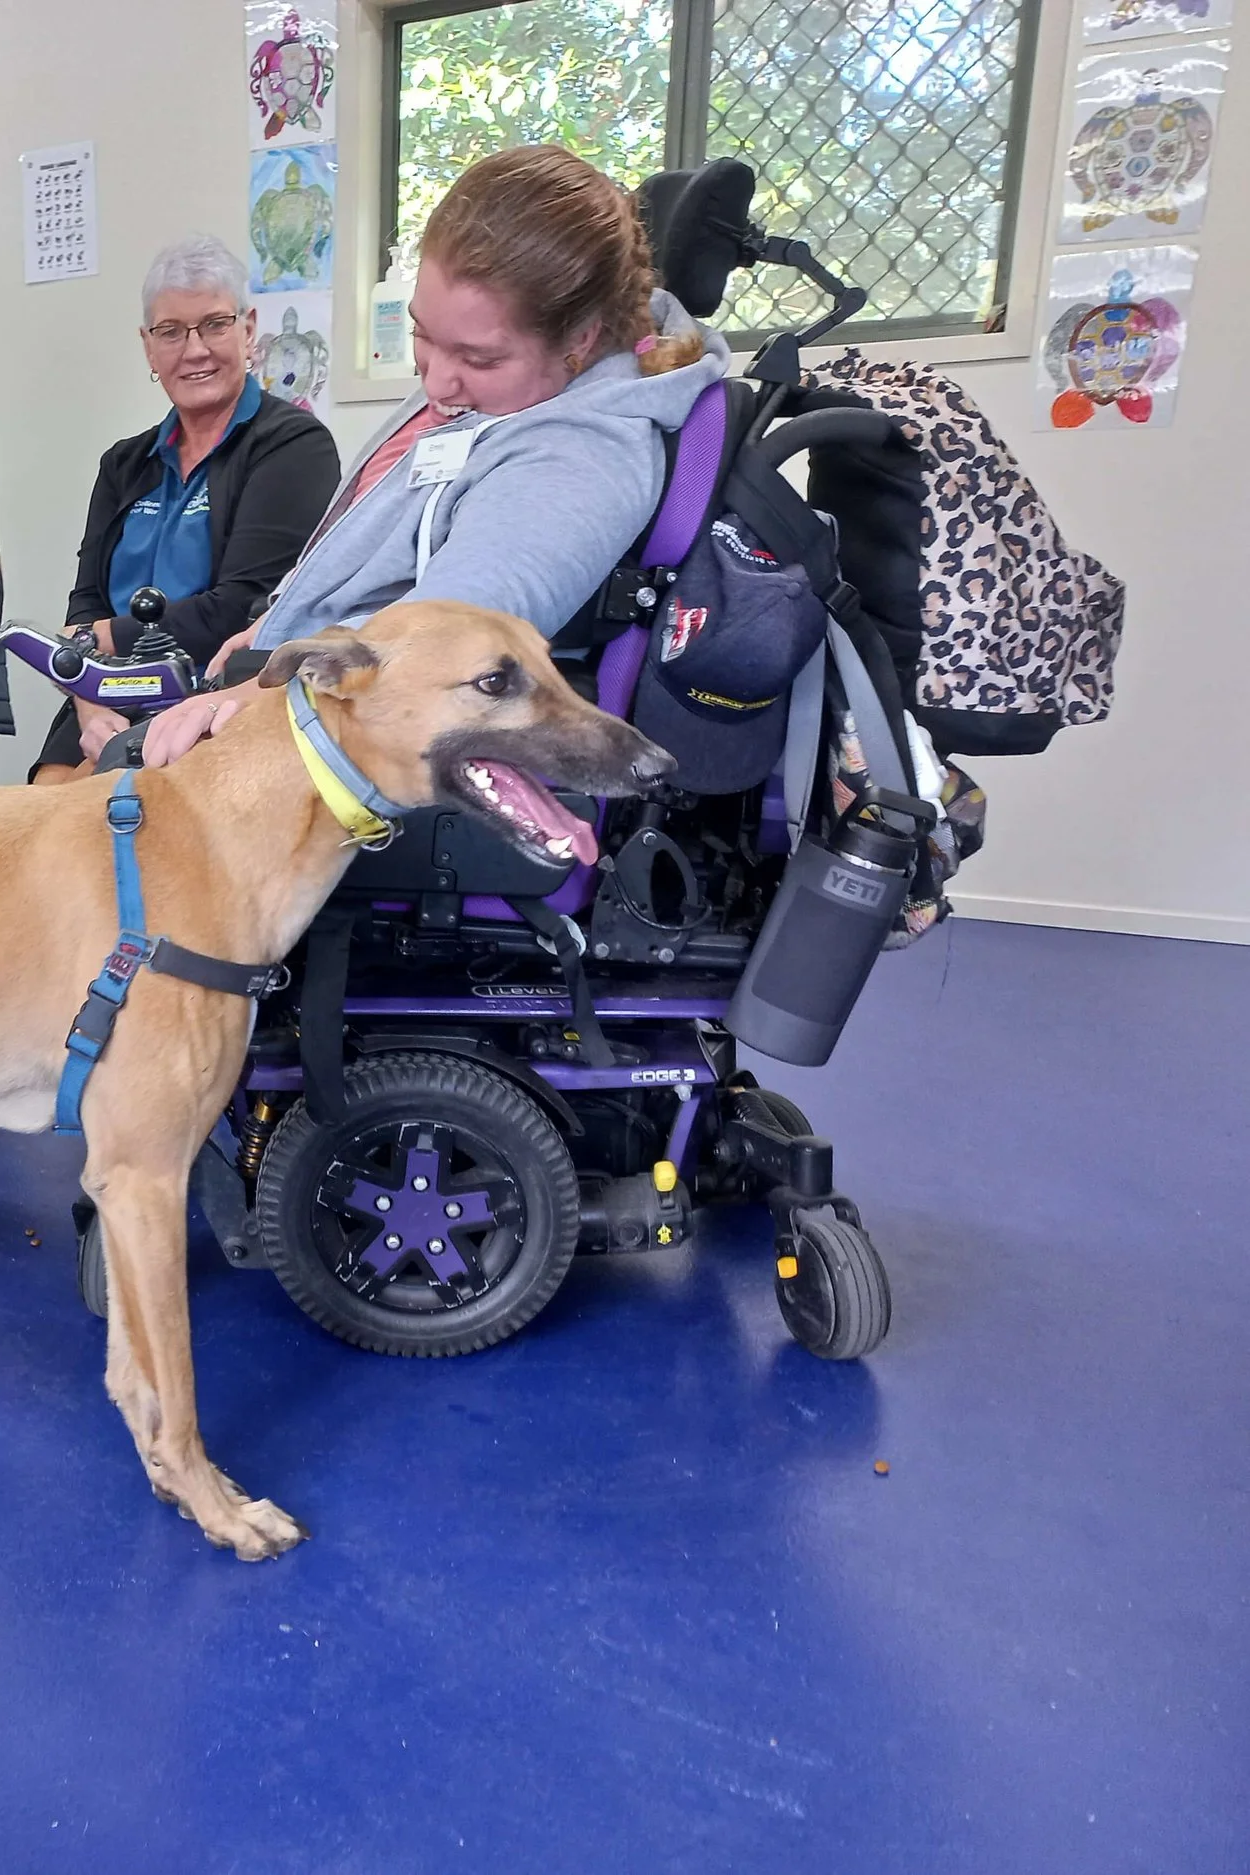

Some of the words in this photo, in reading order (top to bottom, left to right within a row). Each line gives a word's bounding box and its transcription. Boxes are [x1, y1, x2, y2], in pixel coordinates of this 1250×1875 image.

[831, 871, 881, 901] YETI
[631, 1069, 682, 1083] EDGE
[683, 1068, 696, 1082] 3
